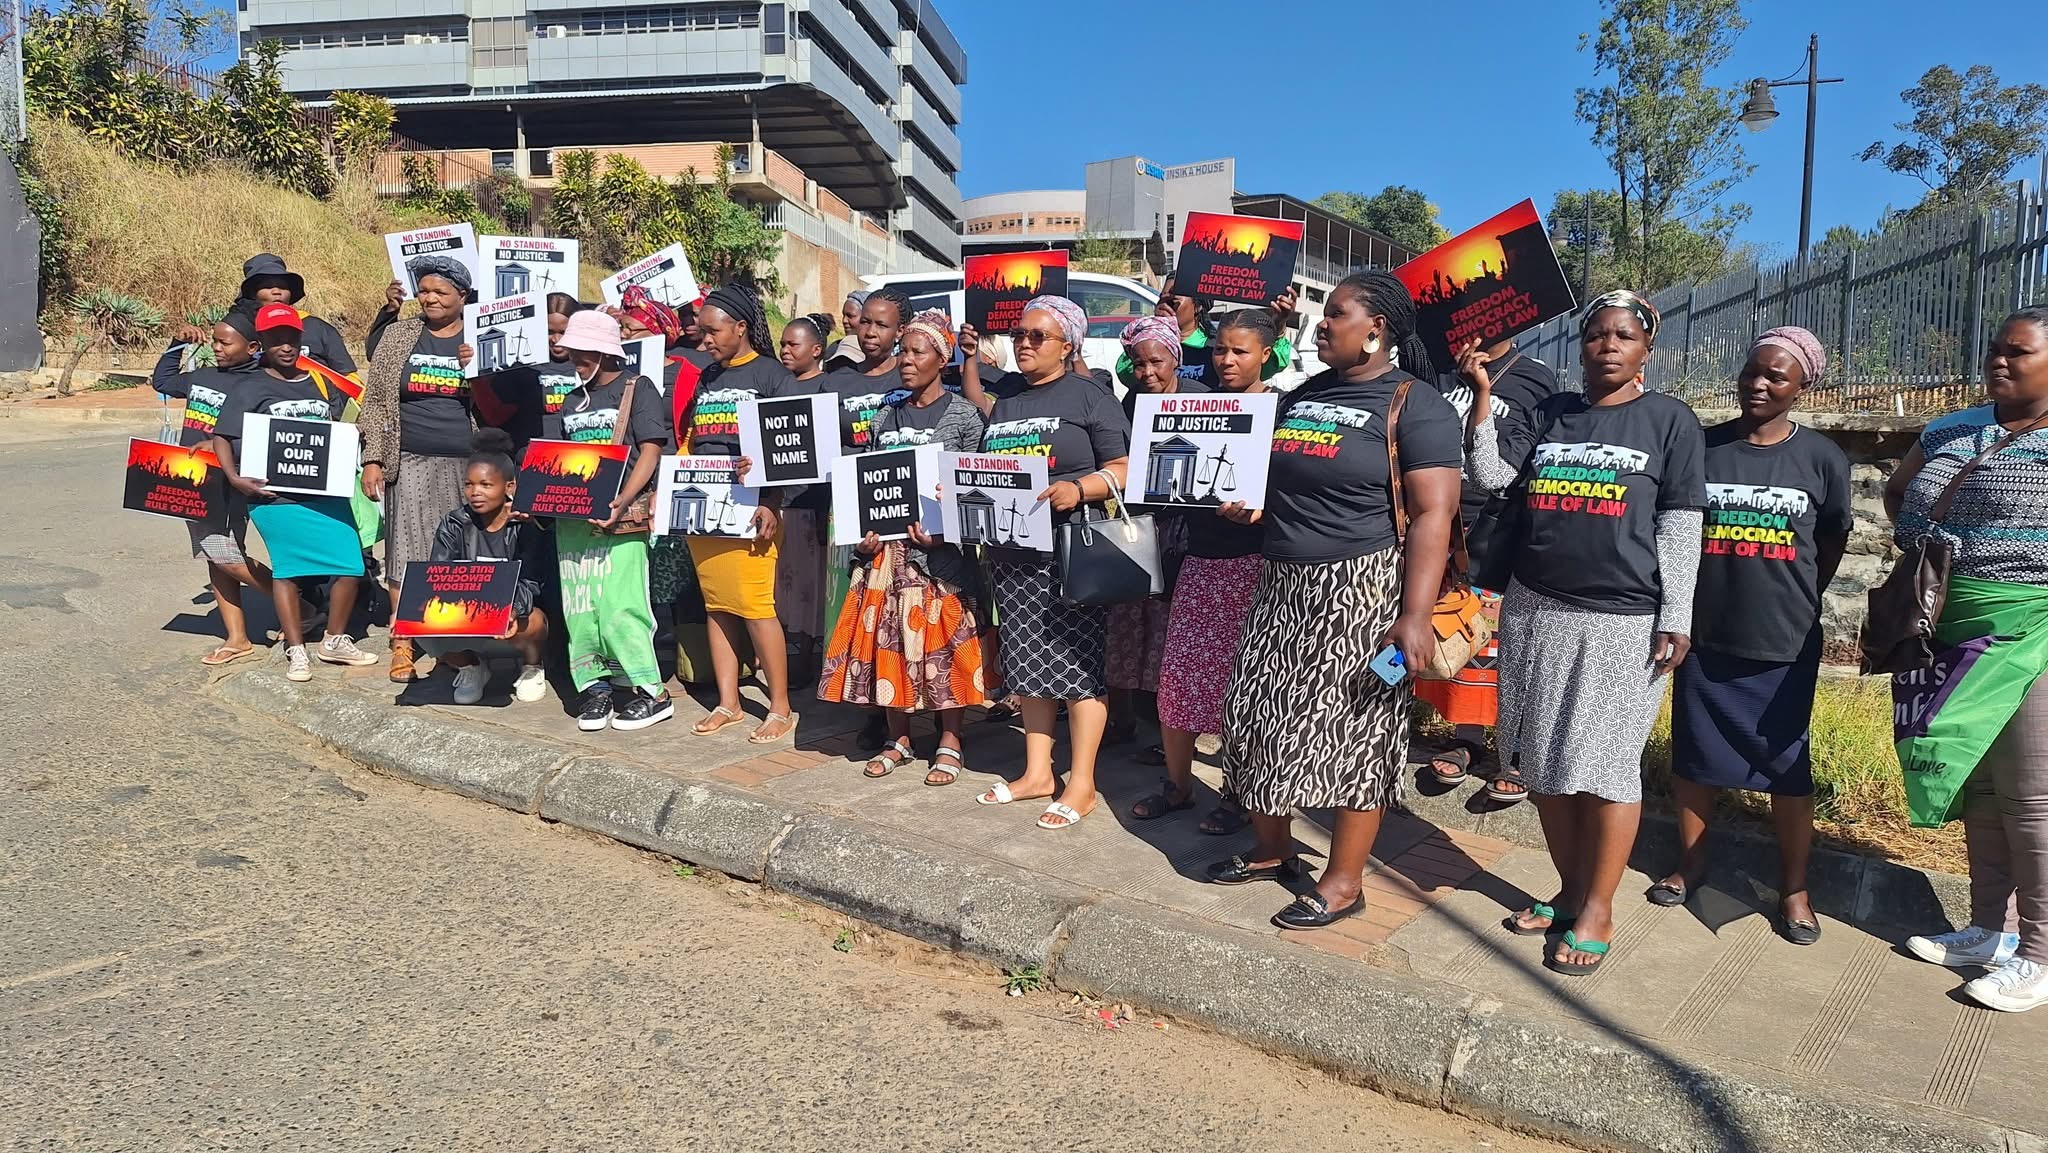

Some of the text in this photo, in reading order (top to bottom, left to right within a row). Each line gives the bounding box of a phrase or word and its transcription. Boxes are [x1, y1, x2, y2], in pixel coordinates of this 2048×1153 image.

[1195, 161, 1224, 176] HOUSE
[403, 229, 453, 243] NO STANDING.
[404, 240, 451, 254] NO JUSTICE.
[500, 240, 557, 250] NO STANDING.
[499, 251, 551, 261] NO JUSTICE.
[617, 254, 665, 282] NO STANDING.
[632, 265, 664, 285] JUSTICE.
[1210, 264, 1259, 279] FREEDOM
[1200, 274, 1266, 290] DEMOCRACY
[1197, 283, 1266, 300] RULE OF LAW
[479, 297, 528, 314] NO STANDING.
[1450, 285, 1516, 325] FREEDOM
[479, 310, 523, 327] NO JUSTICE.
[987, 311, 1023, 320] DEMOC
[1445, 292, 1531, 342] DEMOCRACY
[1484, 321, 1504, 338] OF
[1506, 303, 1539, 328] LAW
[986, 320, 1009, 330] RULE
[420, 366, 464, 378] FREEDO
[408, 382, 436, 393] RULE
[1160, 399, 1243, 413] NO STANDING.
[710, 424, 723, 434] OF
[725, 423, 738, 434] LA
[765, 413, 808, 430] NOT IN
[1158, 416, 1232, 431] NO JUSTICE.
[1281, 418, 1338, 432] FREEDOM
[275, 431, 325, 447] NOT IN
[775, 433, 801, 447] OUR
[985, 434, 1040, 451] FREEDOM
[284, 447, 313, 461] OUR
[1283, 441, 1302, 454] OF
[1302, 442, 1341, 459] LAW
[679, 459, 692, 469] NO
[772, 450, 808, 466] NAME
[958, 457, 1022, 471] NO STANDING.
[277, 462, 319, 477] NAME
[677, 471, 732, 483] NO JUSTICE.
[863, 465, 911, 485] NOT IN
[1539, 465, 1617, 483] FREEDOM
[959, 472, 1017, 487] NO JUSTICE.
[155, 485, 201, 498] FREEDOM
[544, 485, 588, 495] FREEDOM
[873, 486, 903, 502] OUR
[1528, 479, 1628, 501] DEMOCRACY
[147, 492, 208, 509] DEMOCRACY
[535, 494, 593, 505] DEMOCRACY
[1560, 495, 1585, 512] OF
[1586, 498, 1628, 517] LAW
[144, 500, 208, 518] RULE OF LAW
[531, 503, 592, 514] RULE OF LAW
[869, 503, 910, 521] NAME
[1710, 509, 1789, 530] FREEDOM
[1735, 541, 1760, 557] OF
[1763, 543, 1797, 561] LAW
[426, 565, 495, 573] RULE OF LAW
[426, 574, 492, 582] DEMOCRACY
[433, 582, 482, 591] FREEDOM
